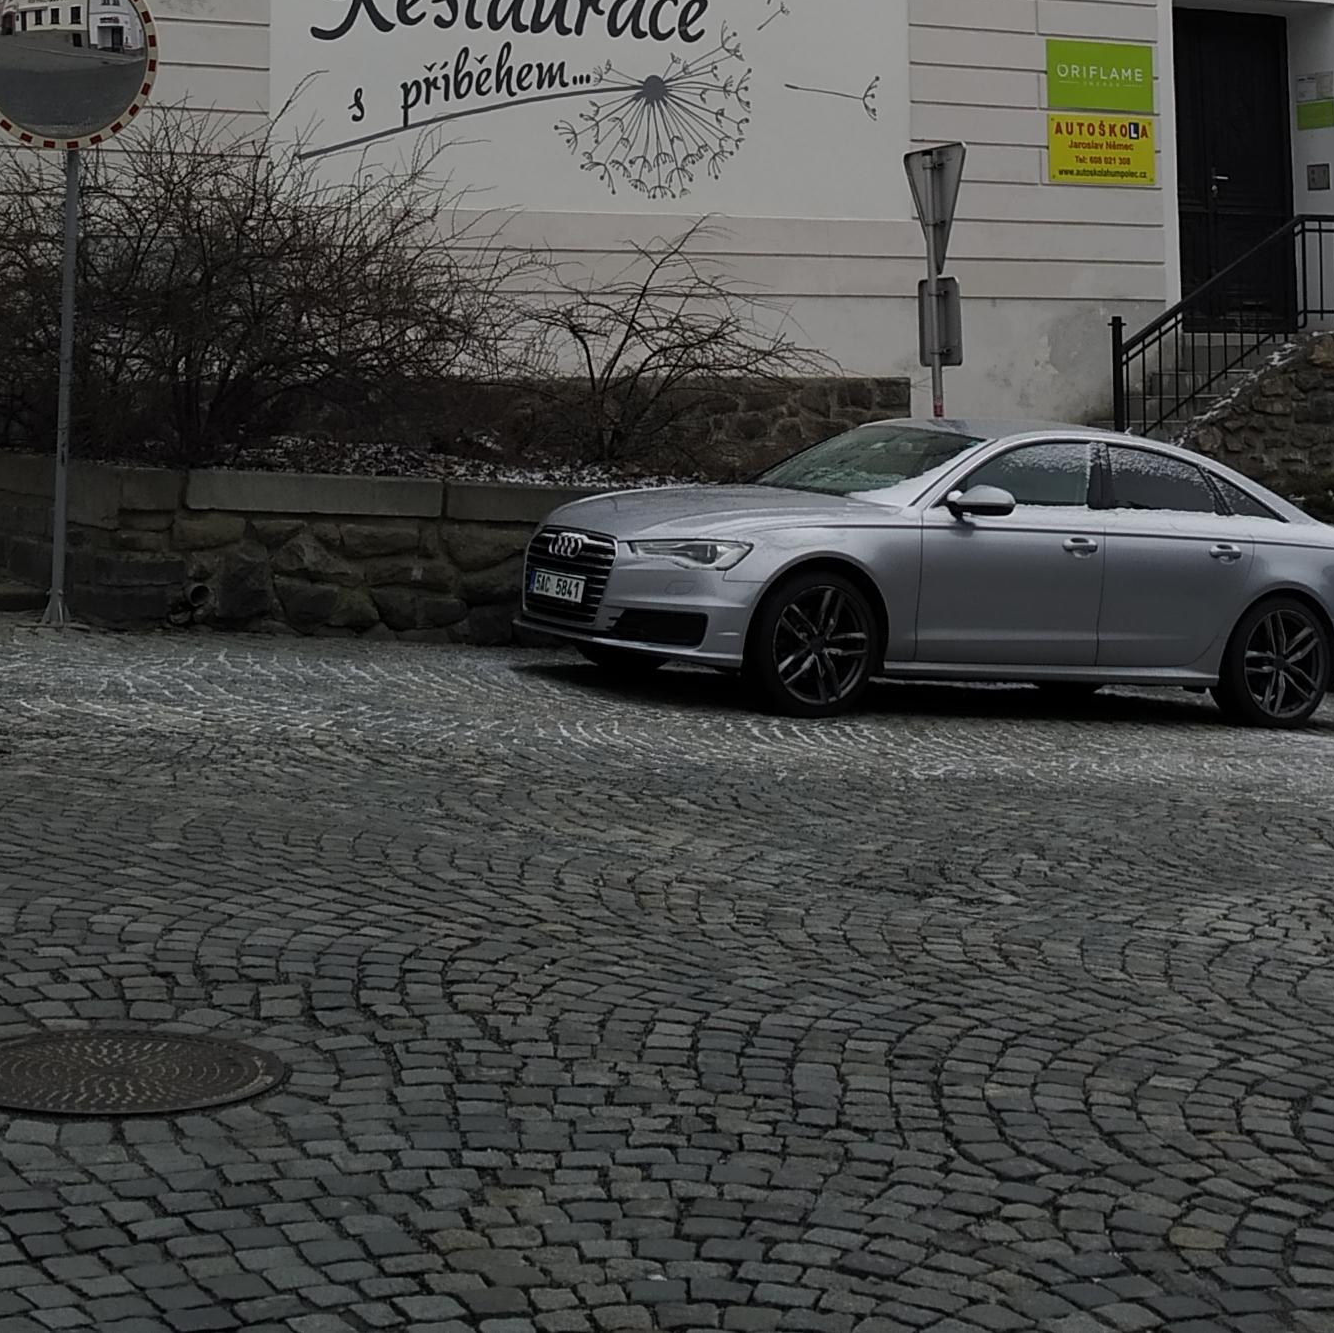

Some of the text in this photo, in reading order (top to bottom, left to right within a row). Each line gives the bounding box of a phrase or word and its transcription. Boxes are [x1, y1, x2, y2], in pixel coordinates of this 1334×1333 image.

[1056, 64, 1144, 82] ORIFLAME
[348, 87, 365, 122] s
[1054, 120, 1149, 139] AUTOŠKOLA
[1068, 140, 1104, 150] Jaroslav
[535, 573, 580, 599] 5AC 5841
